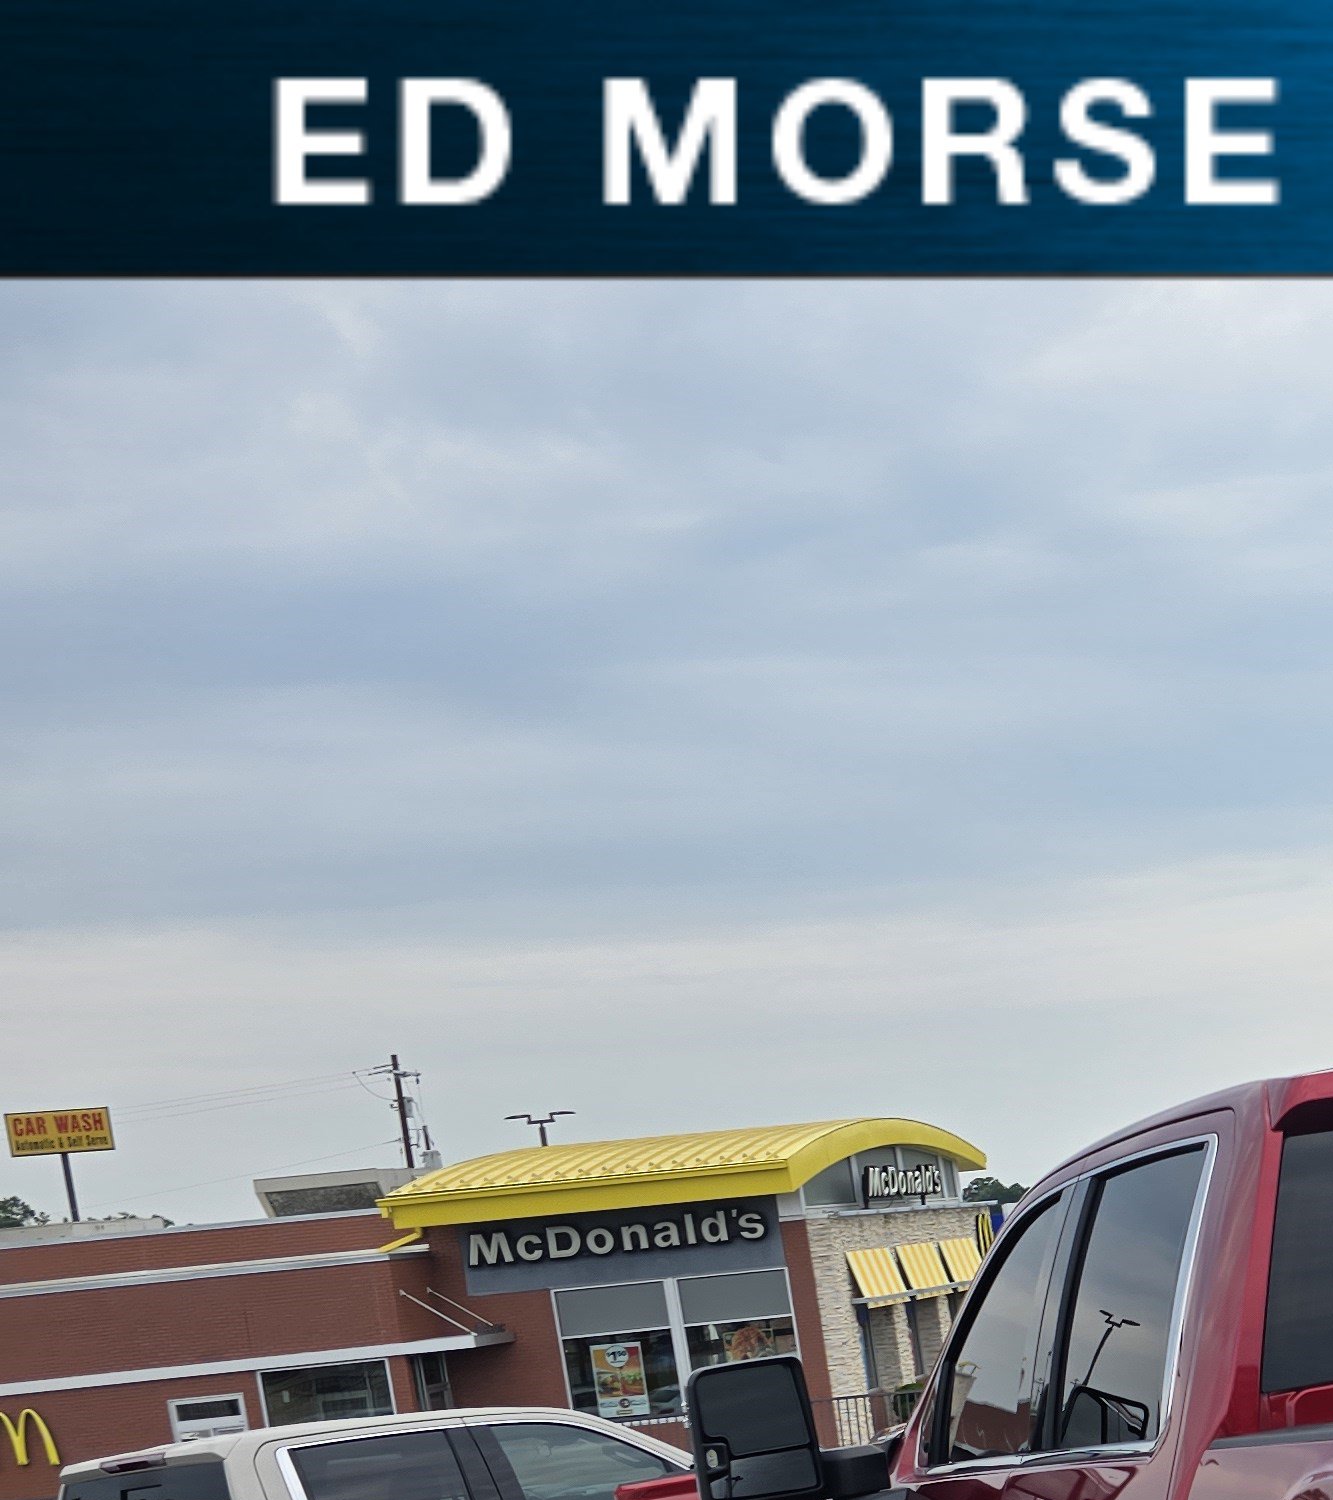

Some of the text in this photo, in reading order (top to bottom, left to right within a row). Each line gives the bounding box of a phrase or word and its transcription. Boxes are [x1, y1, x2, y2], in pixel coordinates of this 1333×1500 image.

[13, 1112, 104, 1137] CAR WASH
[868, 1164, 941, 1198] McDonald's
[469, 1208, 766, 1267] McDonald's
